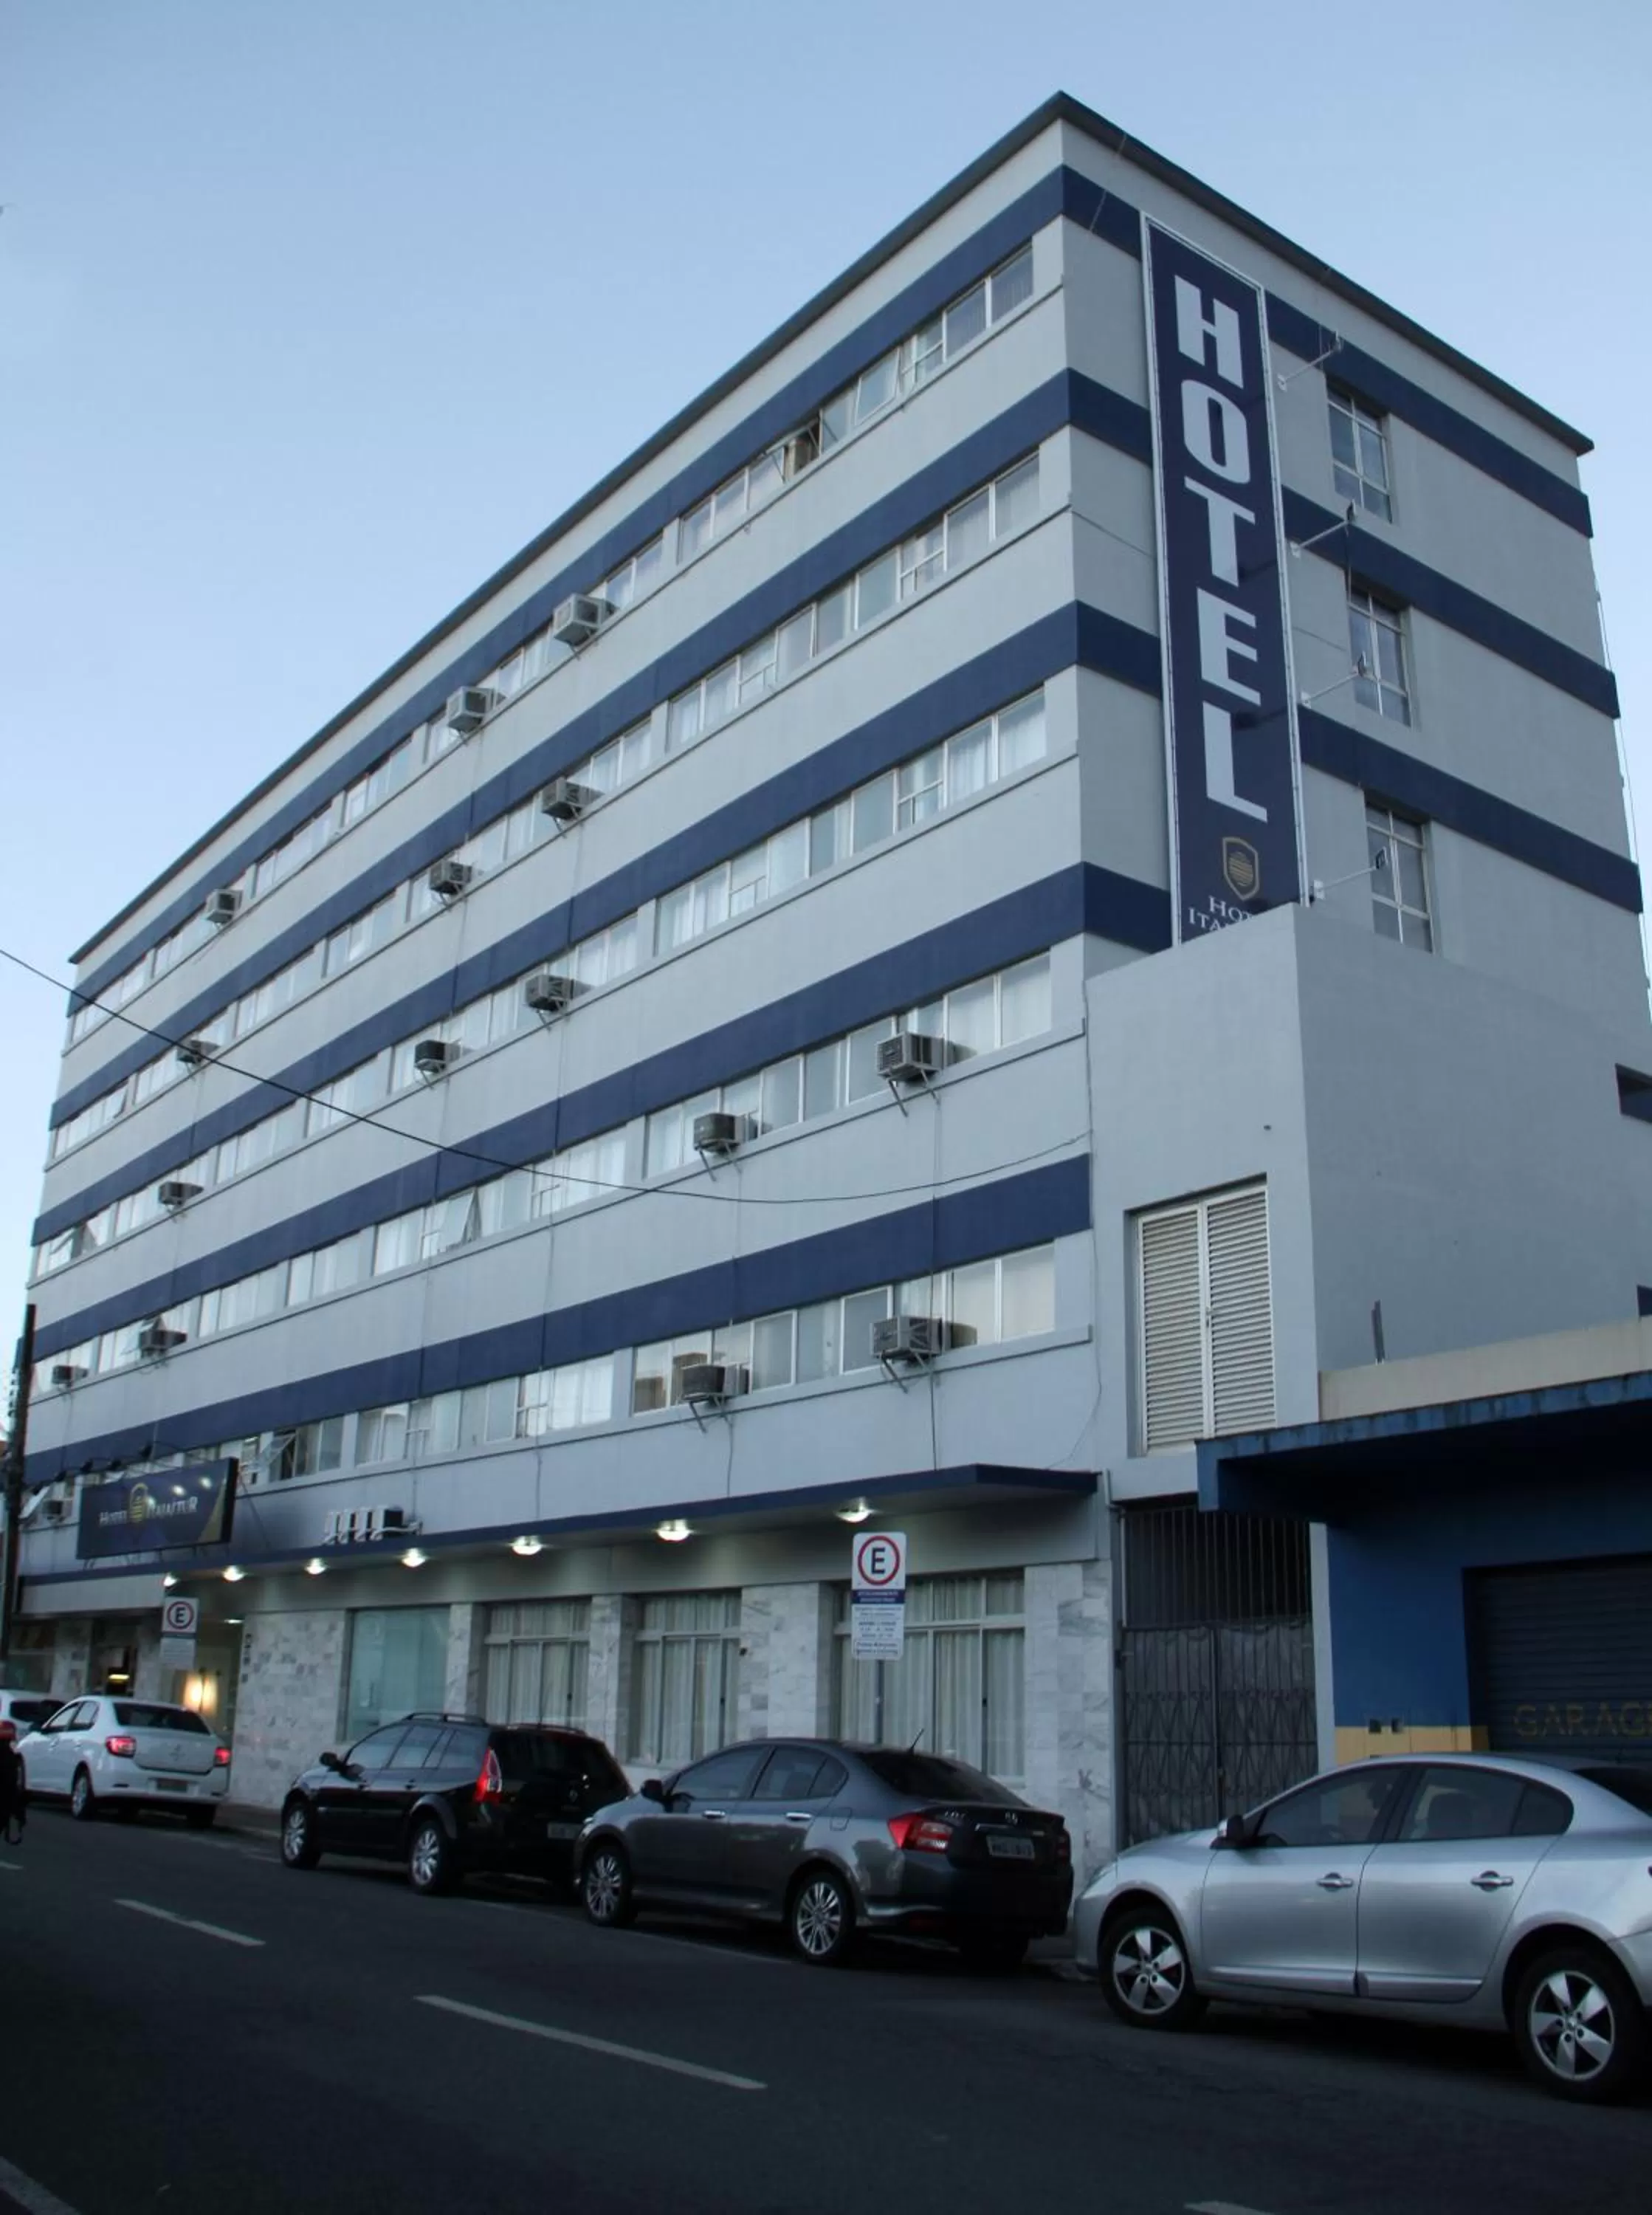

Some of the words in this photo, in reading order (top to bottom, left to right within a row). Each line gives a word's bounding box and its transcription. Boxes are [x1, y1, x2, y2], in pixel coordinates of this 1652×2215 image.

[1174, 274, 1268, 823] HOTEL
[871, 1547, 886, 1575] E
[175, 1607, 185, 1624] E
